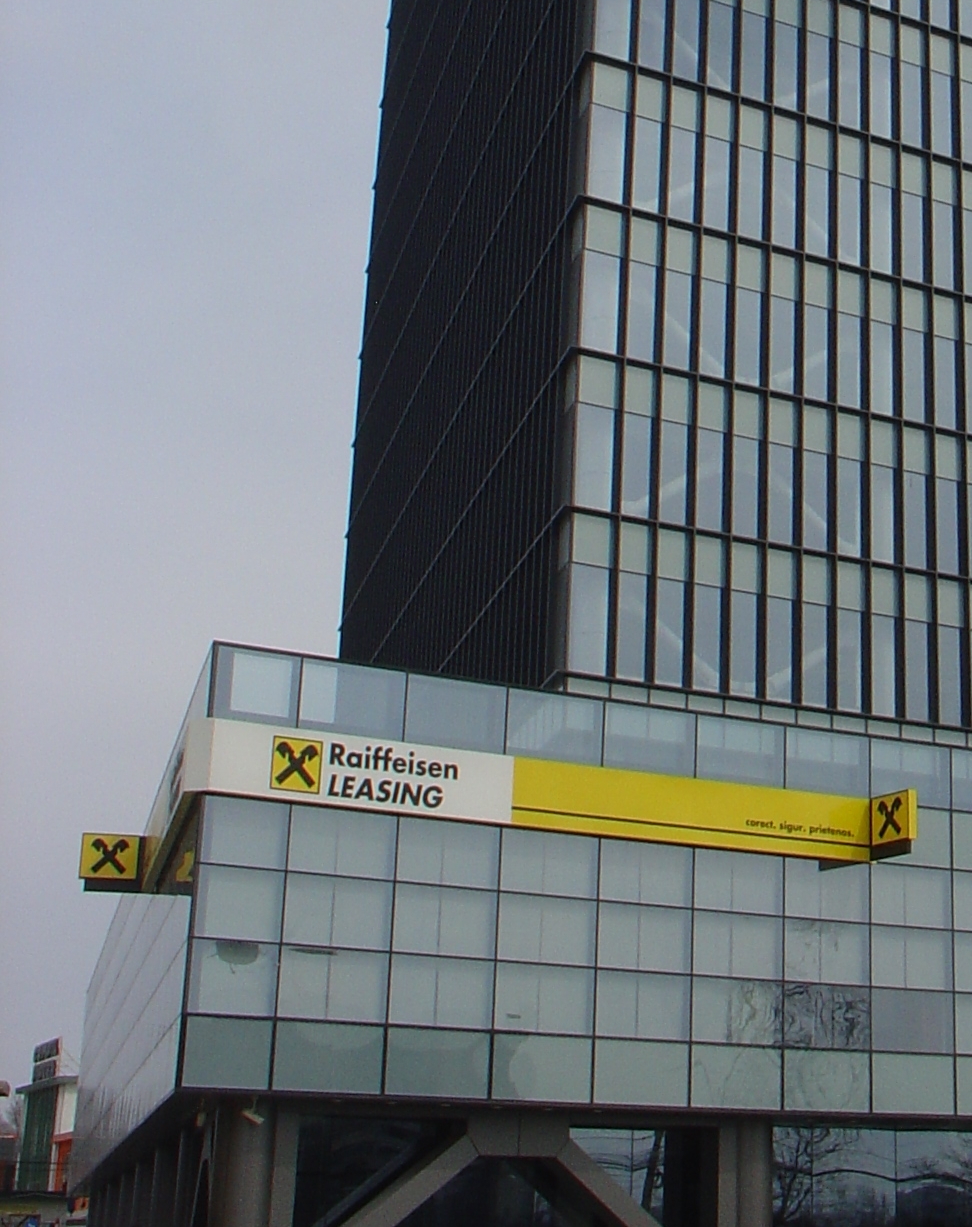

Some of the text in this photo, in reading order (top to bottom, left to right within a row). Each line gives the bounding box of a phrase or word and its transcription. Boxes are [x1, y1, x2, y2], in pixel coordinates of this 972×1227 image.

[329, 743, 459, 780] Raiffeisen
[327, 774, 444, 809] LEASING
[746, 818, 776, 830] corect.
[779, 819, 806, 834] sigur.
